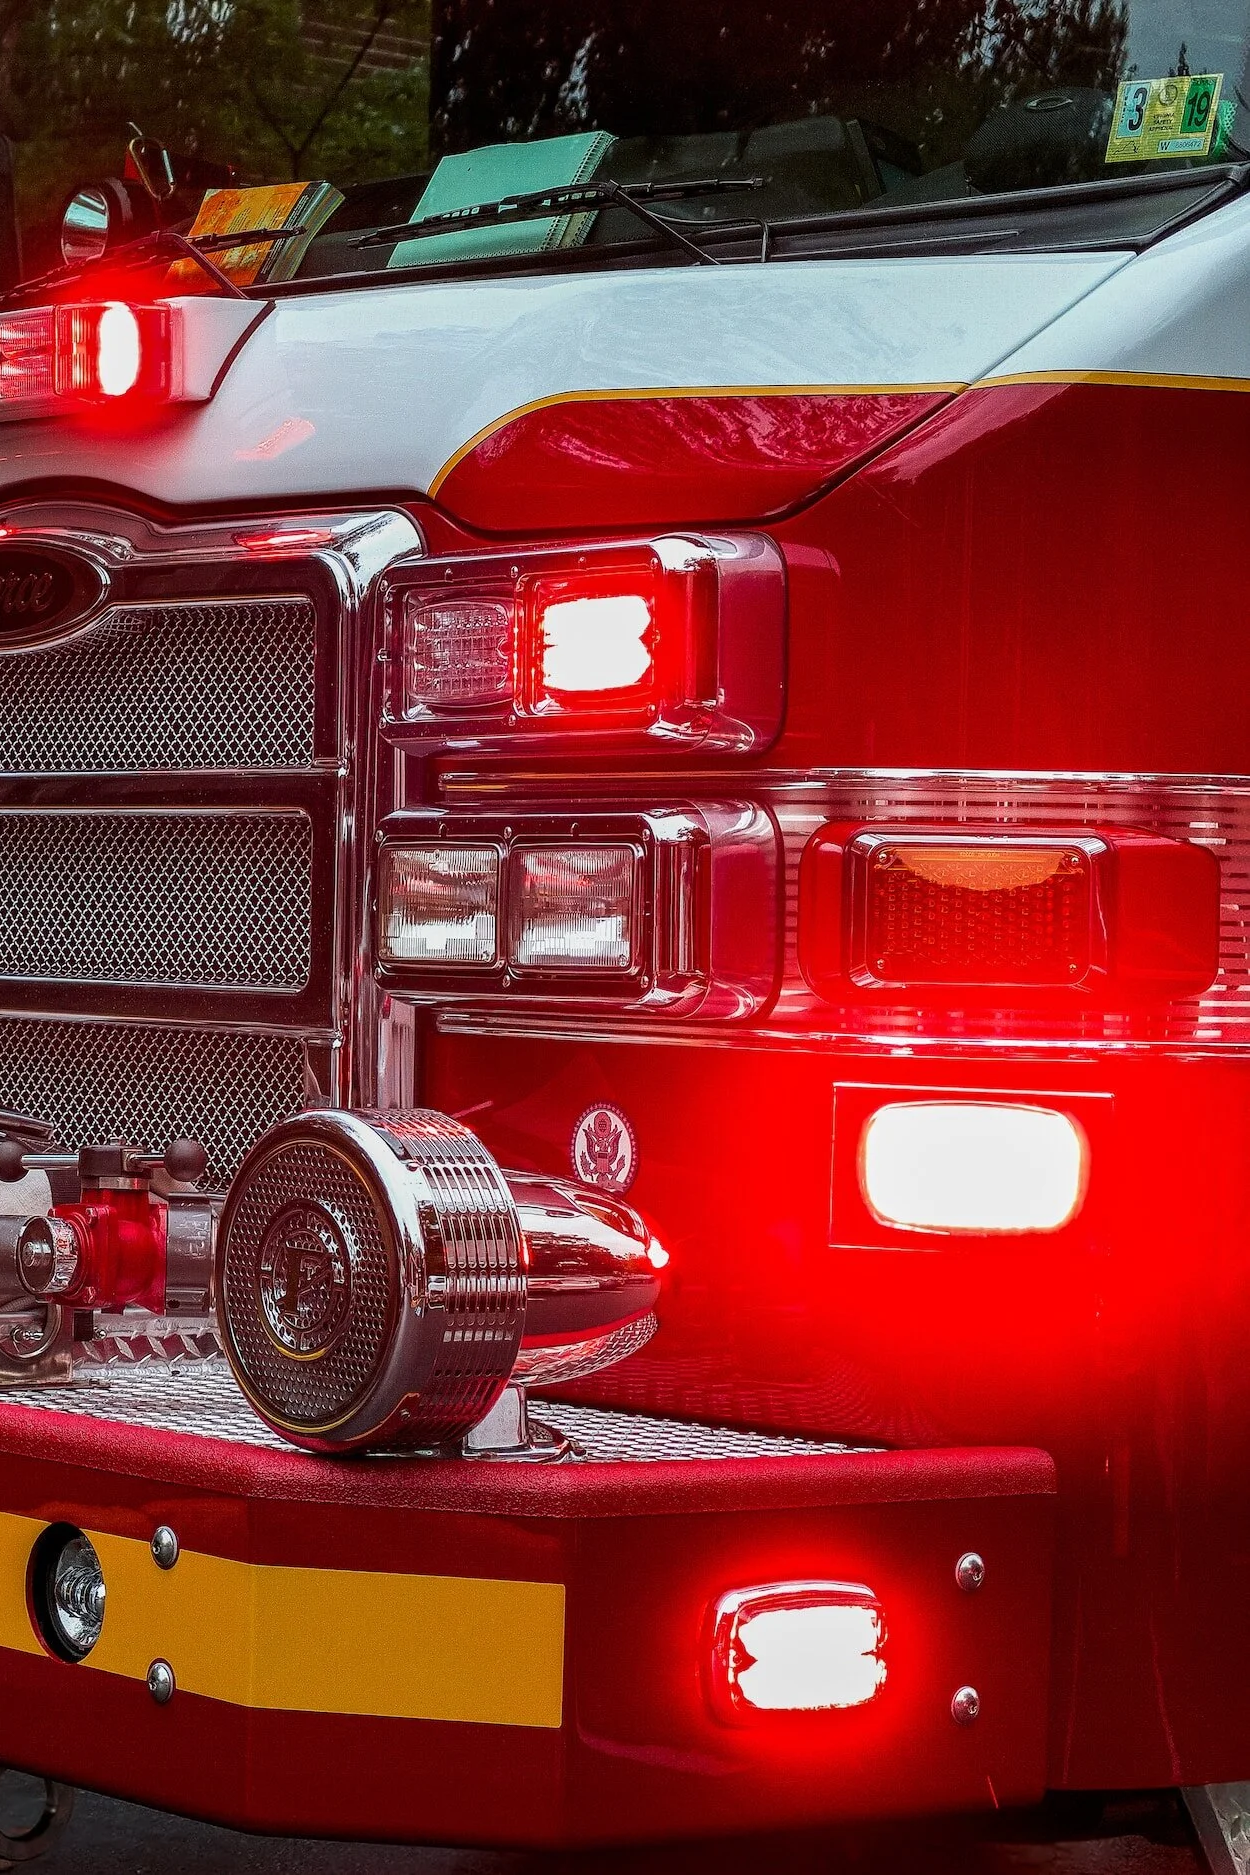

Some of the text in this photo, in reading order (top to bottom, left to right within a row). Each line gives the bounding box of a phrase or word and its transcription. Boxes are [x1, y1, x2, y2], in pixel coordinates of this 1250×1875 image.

[1128, 87, 1148, 131] 3
[1187, 90, 1211, 127] 19
[1160, 141, 1171, 151] W
